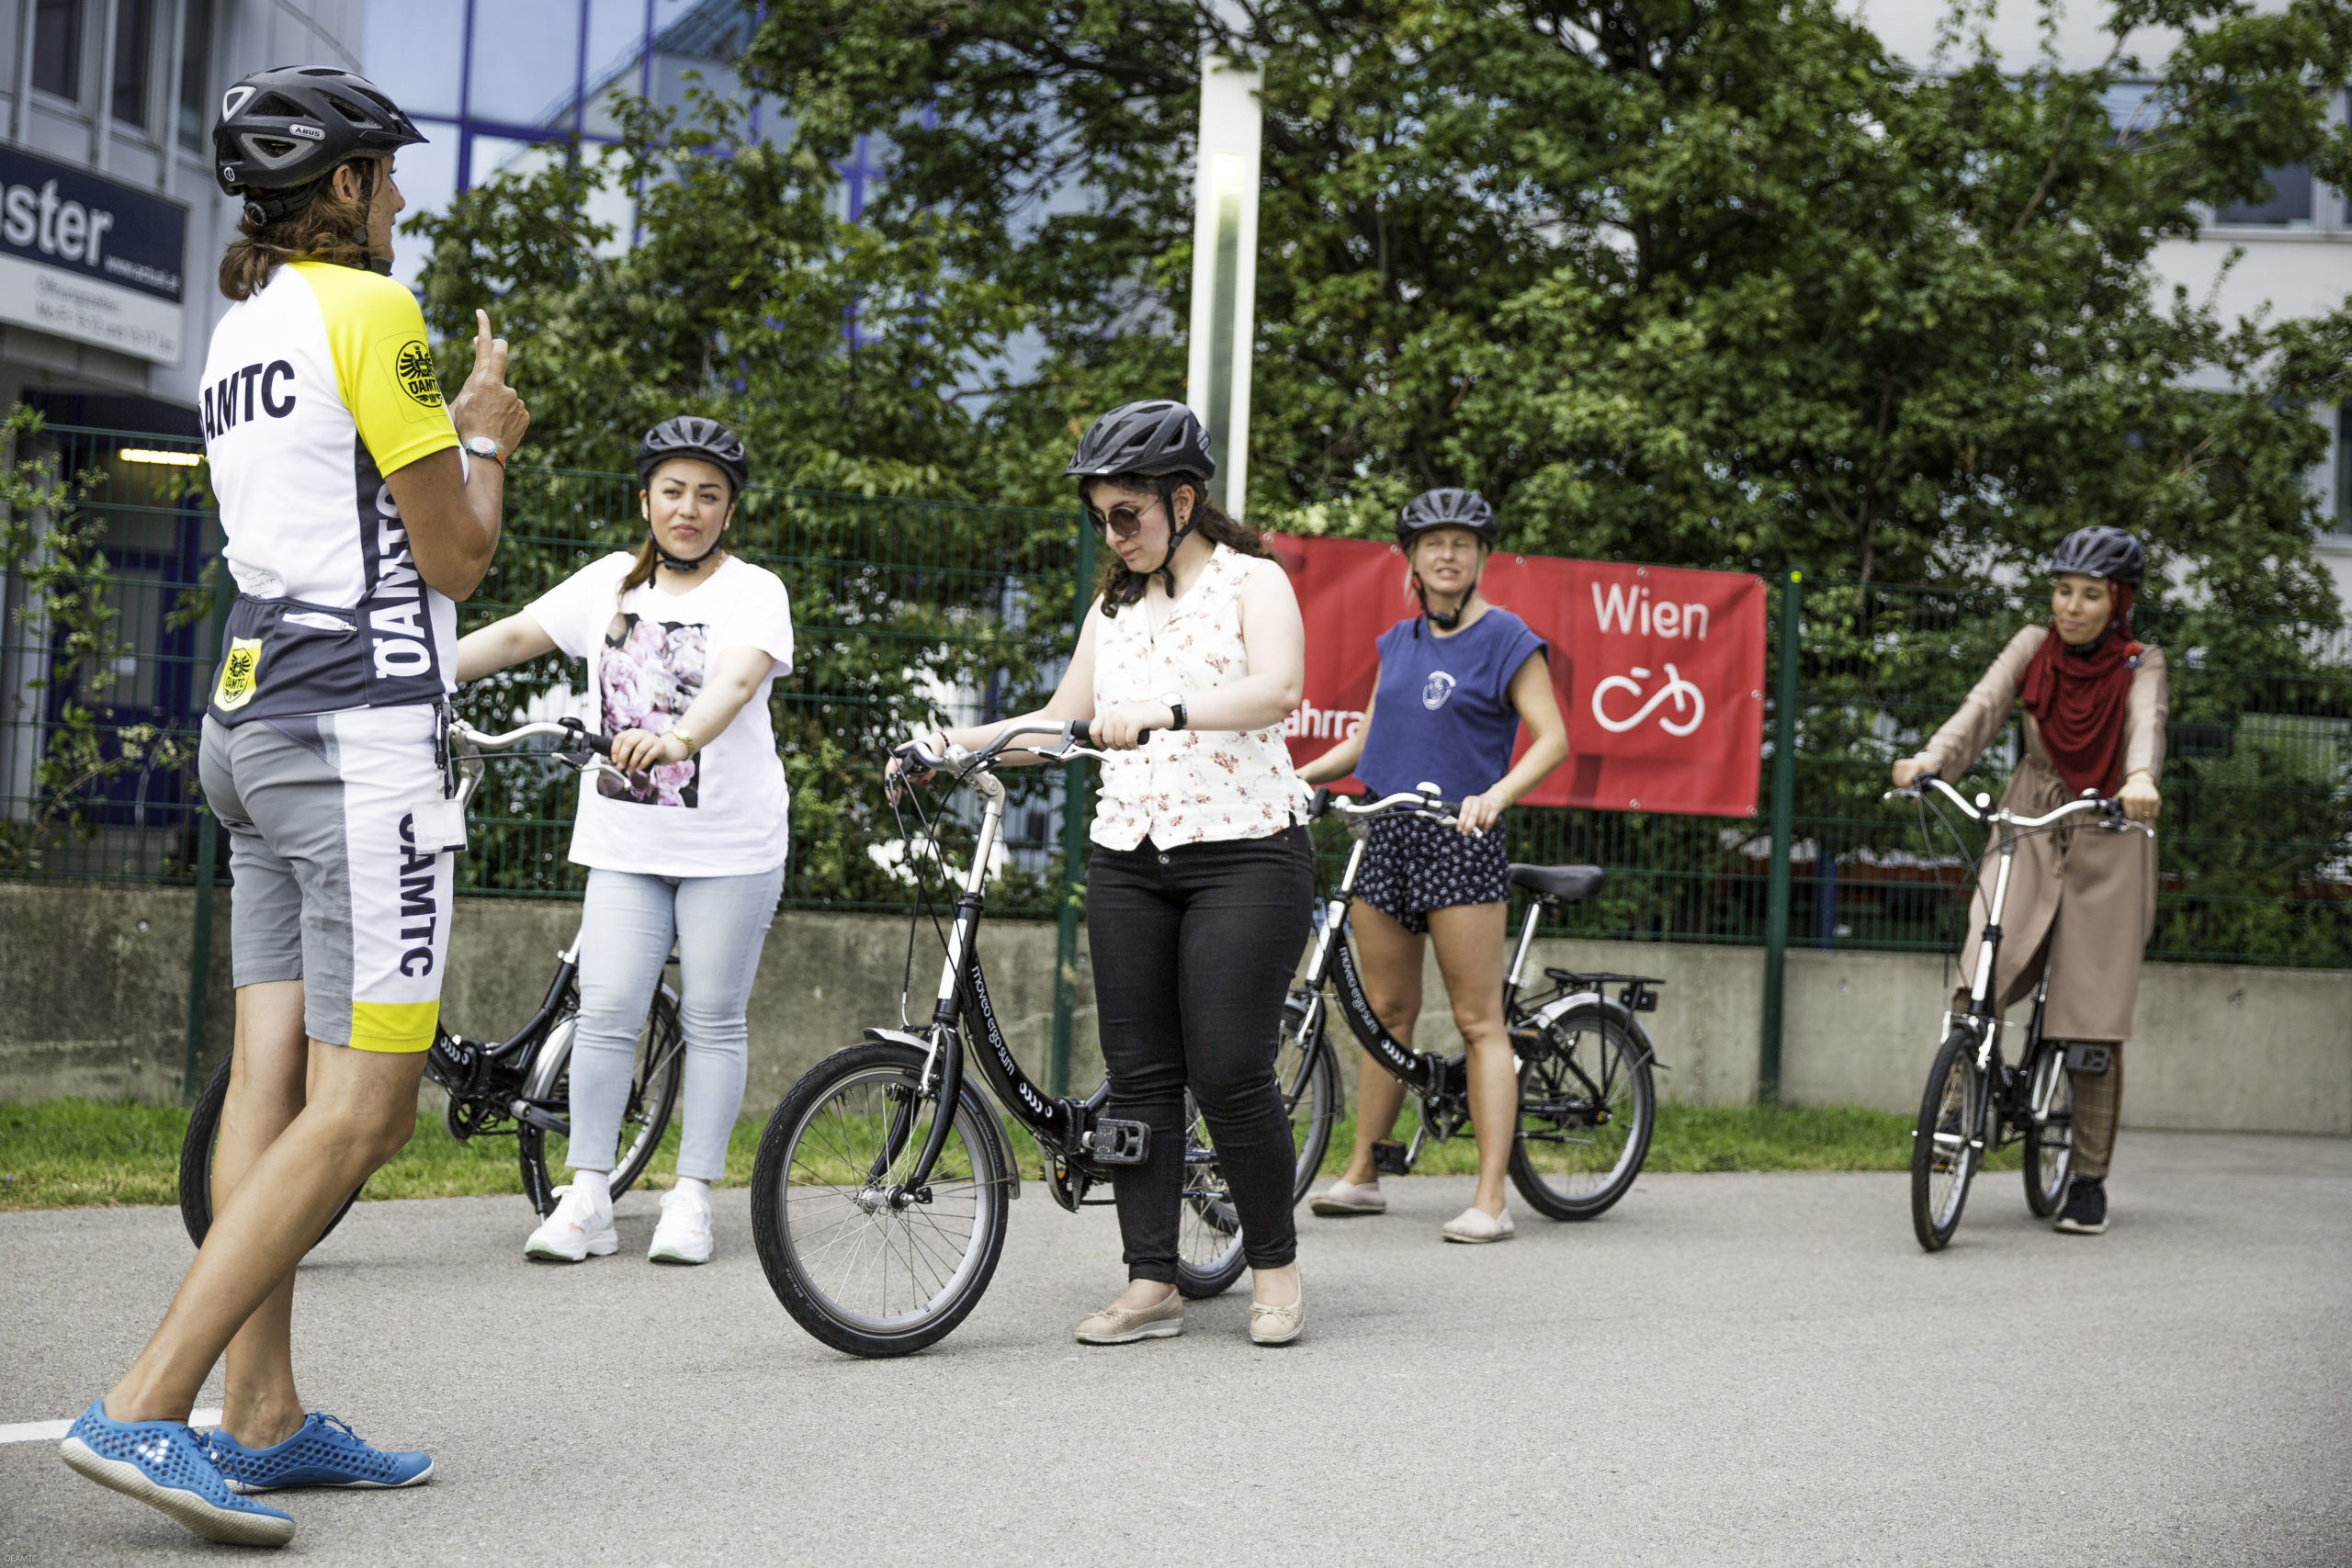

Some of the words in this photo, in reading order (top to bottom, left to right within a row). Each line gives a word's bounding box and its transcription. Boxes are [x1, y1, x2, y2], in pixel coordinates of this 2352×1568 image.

[295, 127, 321, 138] ABUS
[0, 178, 114, 266] ster
[198, 359, 297, 445] AMTC
[408, 378, 440, 395] ÖAMT
[1591, 581, 1709, 641] Wien
[971, 965, 991, 1018] moveo
[987, 1018, 1001, 1048] ergo
[998, 1046, 1015, 1076] sum
[1340, 946, 1358, 988] moveo
[1351, 987, 1367, 1012] ergo
[1362, 1010, 1379, 1035] sum
